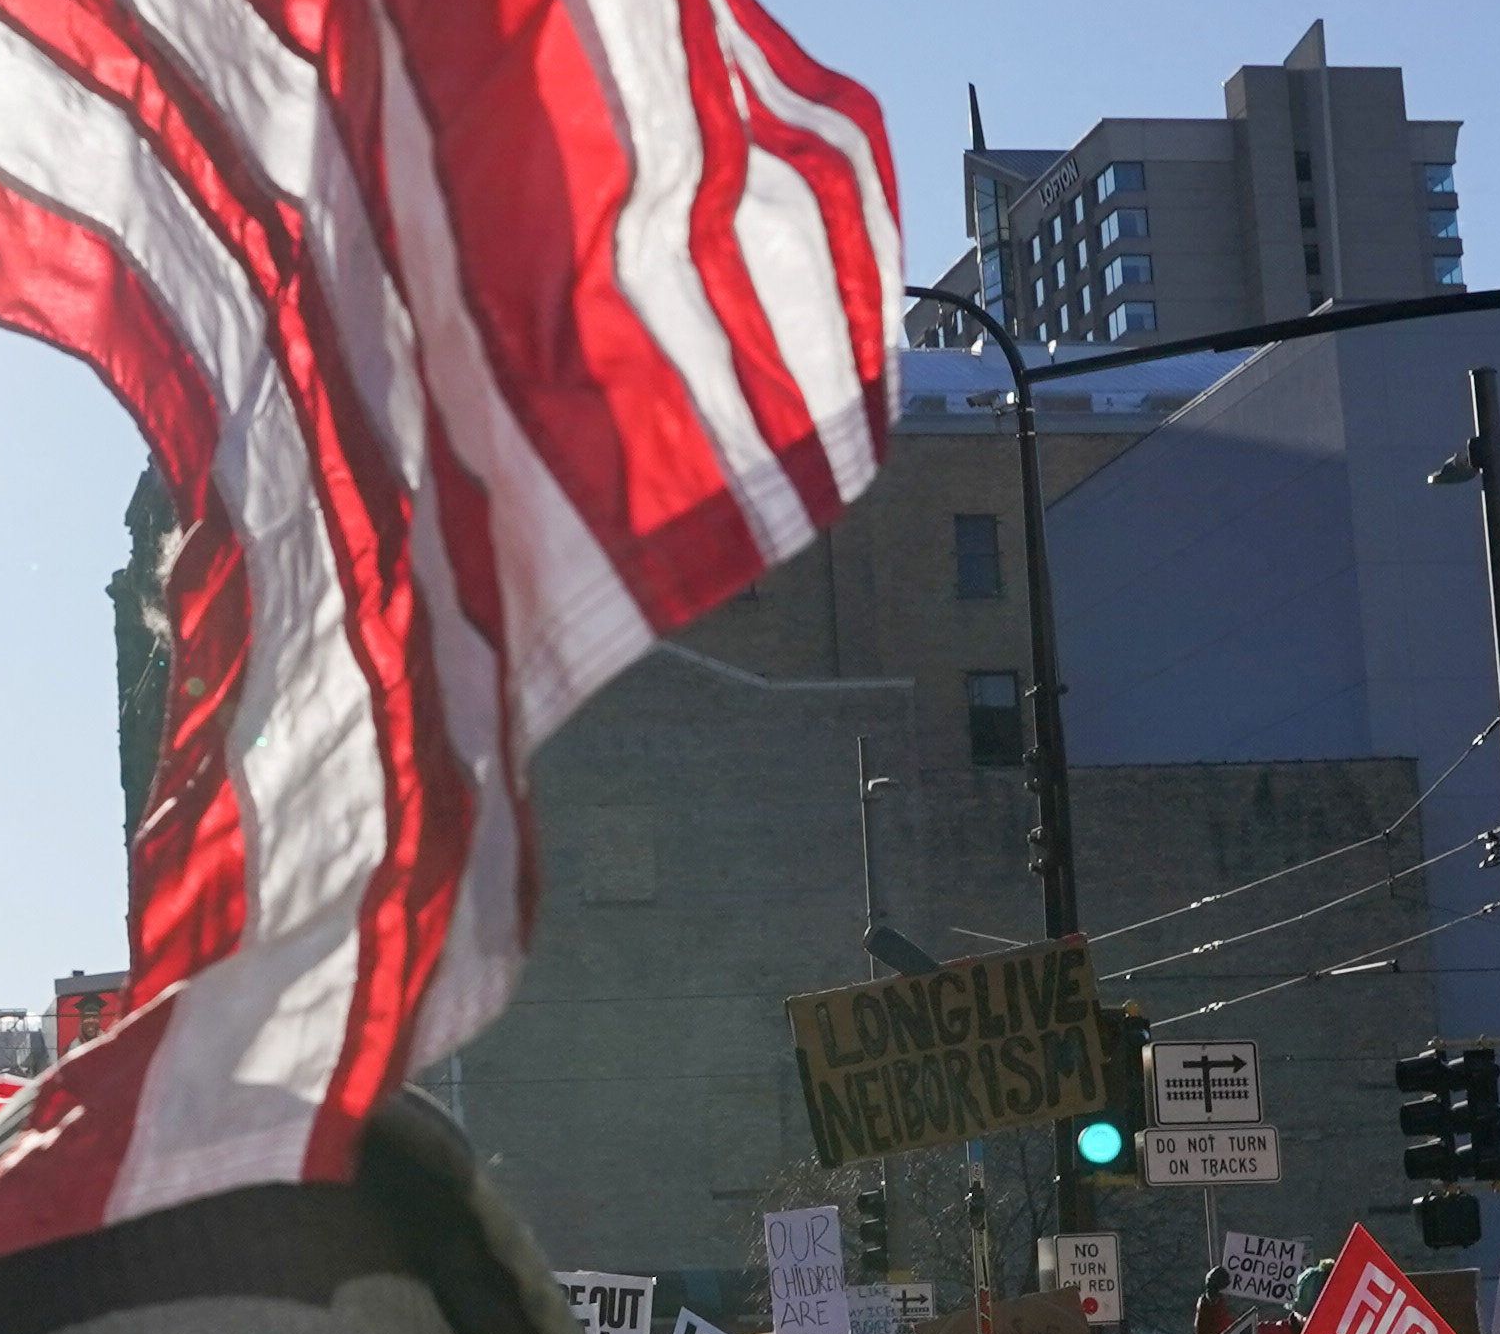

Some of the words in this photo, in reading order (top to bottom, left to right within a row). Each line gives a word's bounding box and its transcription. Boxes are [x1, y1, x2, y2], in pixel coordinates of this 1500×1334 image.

[1156, 1138, 1176, 1154] DO
[1188, 1137, 1216, 1153] NOT
[1228, 1135, 1267, 1152] TURN
[1169, 1160, 1189, 1175] ON
[1201, 1158, 1258, 1174] TRACKS
[769, 1214, 837, 1262] OUR
[1074, 1243, 1099, 1259] NO
[1244, 1237, 1296, 1261] LIAM
[1070, 1262, 1107, 1276] TURN
[1089, 1279, 1115, 1292] RED
[1232, 1274, 1298, 1301] RAMOS
[589, 1285, 645, 1329] OUT
[780, 1300, 830, 1329] ARE
